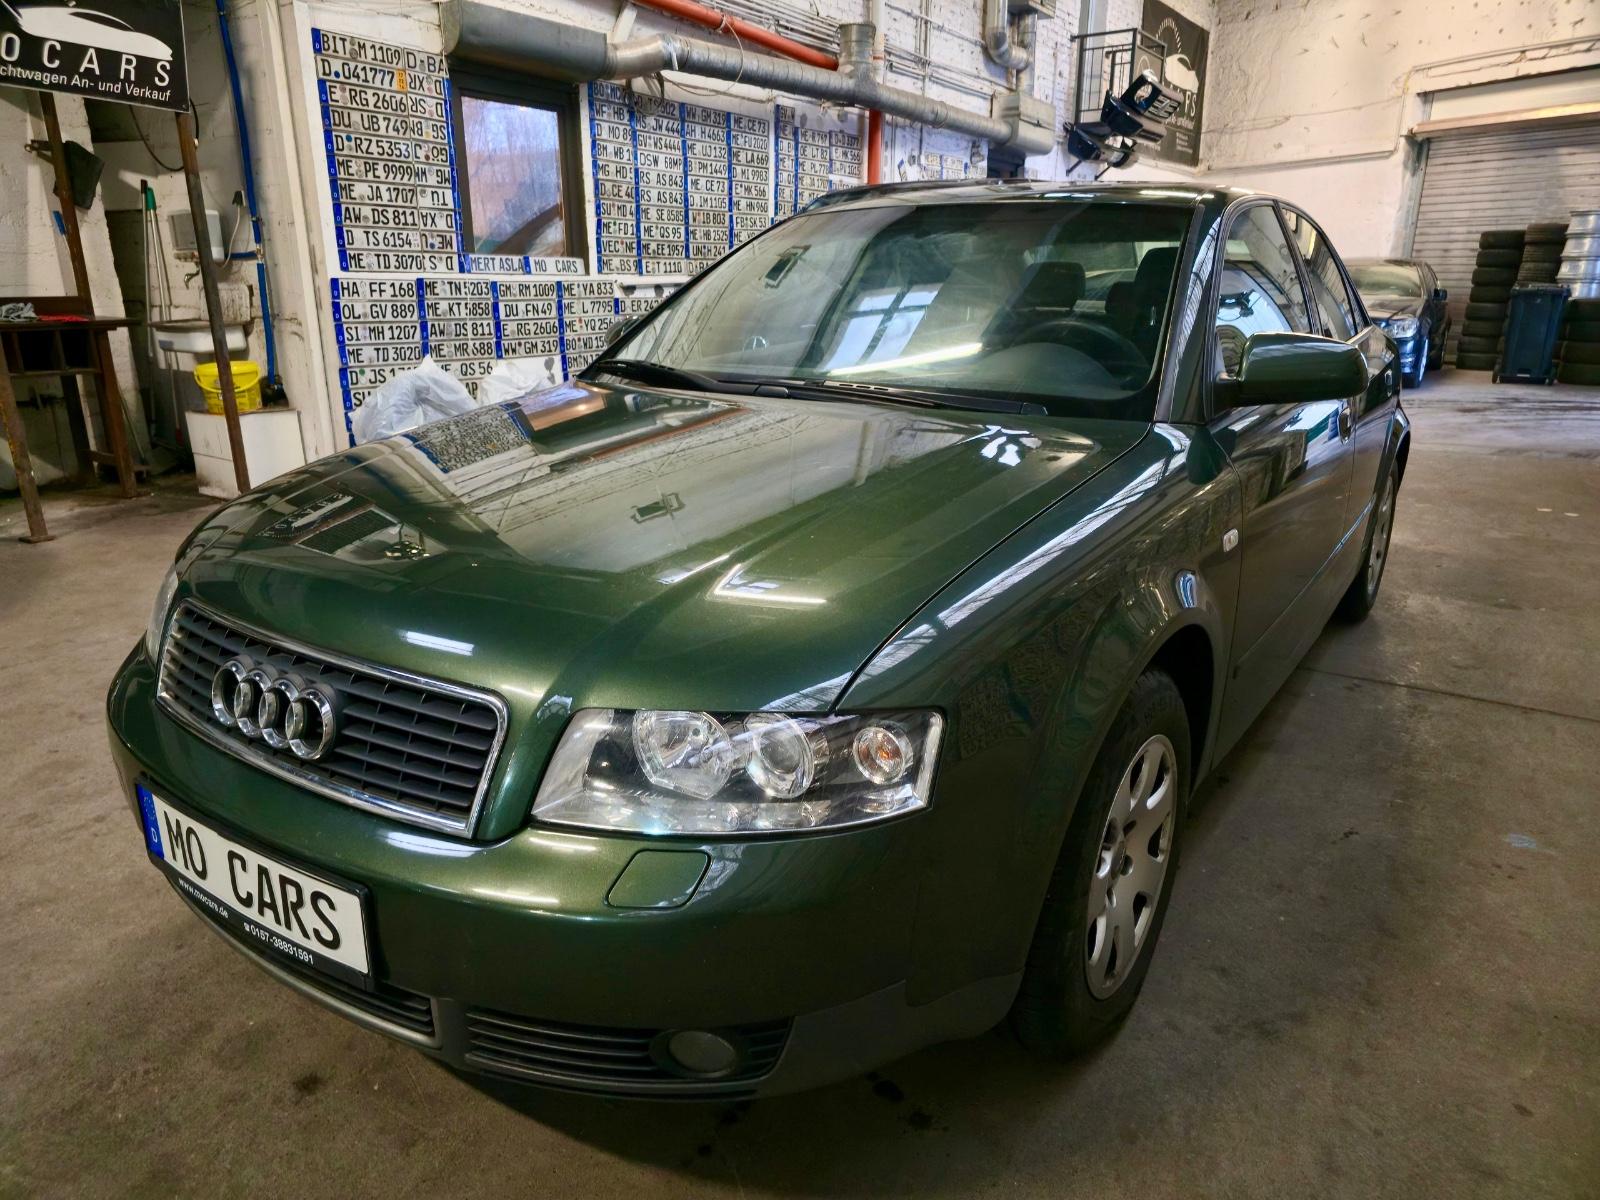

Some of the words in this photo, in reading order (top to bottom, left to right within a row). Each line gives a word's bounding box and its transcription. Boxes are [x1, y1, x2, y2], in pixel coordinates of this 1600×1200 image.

[322, 33, 347, 55] BIT
[357, 41, 367, 59] M
[370, 44, 400, 65] 1109
[42, 41, 171, 86] CARS
[321, 59, 331, 76] D
[71, 74, 94, 89] An-
[99, 82, 121, 93] und
[126, 82, 170, 101] Verkauf
[328, 85, 339, 103] E
[349, 88, 369, 108] RG
[372, 93, 406, 113] 2606
[331, 110, 351, 129] DU
[361, 113, 380, 134] UB
[383, 116, 408, 136] 749
[335, 134, 344, 152] D
[354, 137, 373, 155] RZ
[376, 140, 411, 159] 5353
[337, 158, 354, 177] ME
[364, 162, 380, 178] PE
[383, 163, 413, 182] 9999
[339, 183, 357, 200] ME
[367, 185, 383, 202] JA
[385, 187, 415, 204] 1707
[343, 207, 361, 223] AW
[371, 208, 389, 225] DS
[392, 209, 418, 226] 811
[346, 229, 354, 246] D
[363, 231, 380, 247] TS
[383, 232, 412, 248] 6154
[348, 252, 366, 269] ME
[374, 253, 391, 270] TD
[394, 254, 422, 270] 3070
[470, 257, 496, 272] MERT
[534, 259, 547, 272] MO
[555, 260, 578, 273] CARS
[340, 281, 360, 298] HA
[369, 282, 387, 298] FF
[390, 282, 415, 298] 168
[425, 281, 440, 296] ME
[447, 281, 462, 296] TN
[499, 284, 512, 298] GM
[518, 284, 532, 297] RM
[533, 283, 555, 297] 1009
[563, 284, 576, 297] ME
[582, 283, 596, 296] YA
[597, 282, 614, 295] 833
[342, 304, 361, 319] OL
[370, 304, 388, 319] GV
[391, 304, 415, 319] 889
[427, 302, 441, 317] ME
[449, 302, 462, 317] KT
[504, 304, 519, 318] DU
[525, 303, 540, 317] FN
[541, 302, 553, 316] 49
[564, 302, 576, 315] ME
[590, 300, 613, 314] 7795
[346, 326, 361, 341] SI
[369, 326, 385, 341] MH
[388, 325, 417, 341] 1207
[430, 323, 446, 337] AW
[454, 323, 468, 337] DS
[471, 322, 493, 336] 811
[503, 323, 510, 337] E
[517, 323, 532, 337] RG
[533, 321, 558, 335] 2606
[565, 320, 578, 333] ME
[347, 348, 364, 363] ME
[374, 347, 389, 362] TD
[392, 346, 421, 362] 3020
[430, 343, 446, 358] ME
[454, 343, 470, 357] MR
[503, 342, 517, 355] WW
[524, 341, 538, 354] GM
[541, 340, 558, 353] 319
[350, 370, 359, 386] D
[369, 368, 387, 384] JS
[460, 363, 476, 376] QS
[164, 810, 208, 880] MO
[228, 850, 342, 950] CARS
